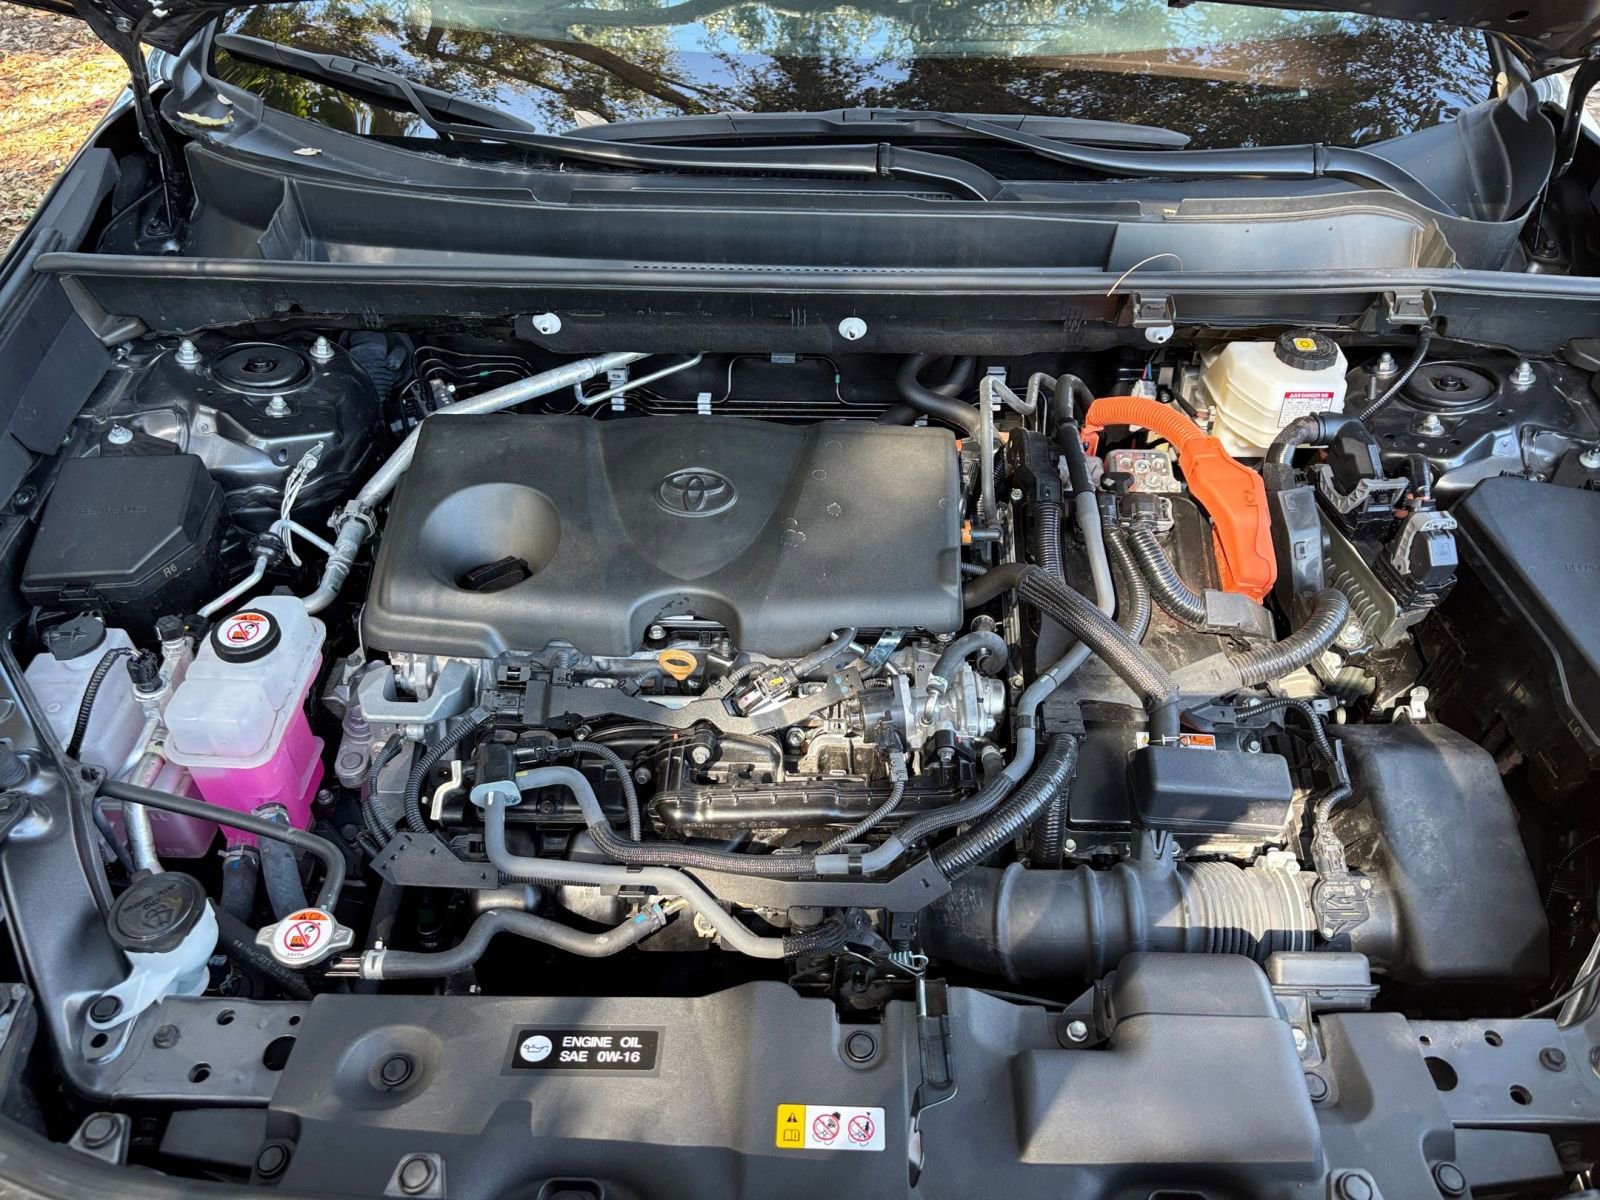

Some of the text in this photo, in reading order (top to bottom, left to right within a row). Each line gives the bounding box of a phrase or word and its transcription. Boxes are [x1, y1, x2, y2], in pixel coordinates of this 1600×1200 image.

[163, 563, 177, 577] R6
[562, 1036, 642, 1048] ENGINE OIL
[559, 1050, 641, 1063] SAE 0W-16
